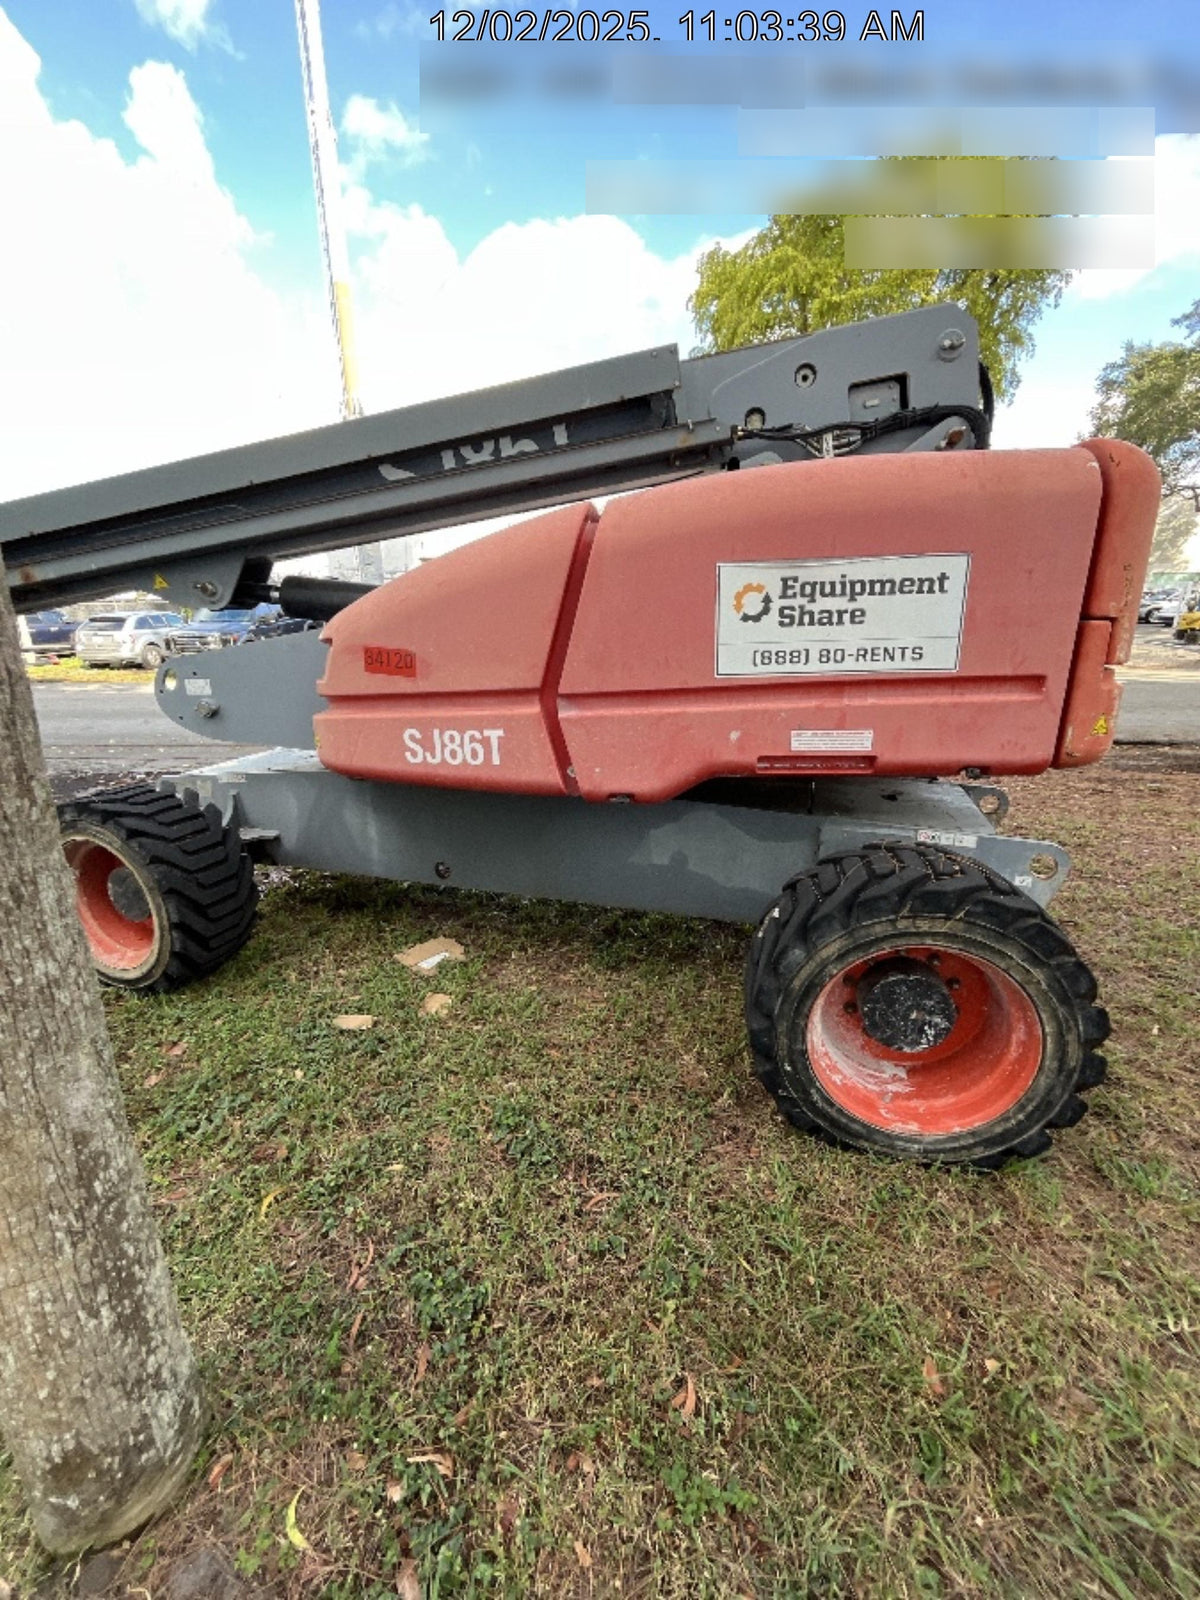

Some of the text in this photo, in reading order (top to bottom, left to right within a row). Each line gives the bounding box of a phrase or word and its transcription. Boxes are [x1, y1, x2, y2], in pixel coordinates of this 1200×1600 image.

[778, 572, 950, 602] Equipment
[778, 604, 866, 628] Share
[752, 646, 924, 667] (888) 80-RENTS
[403, 728, 505, 766] SJ86T
